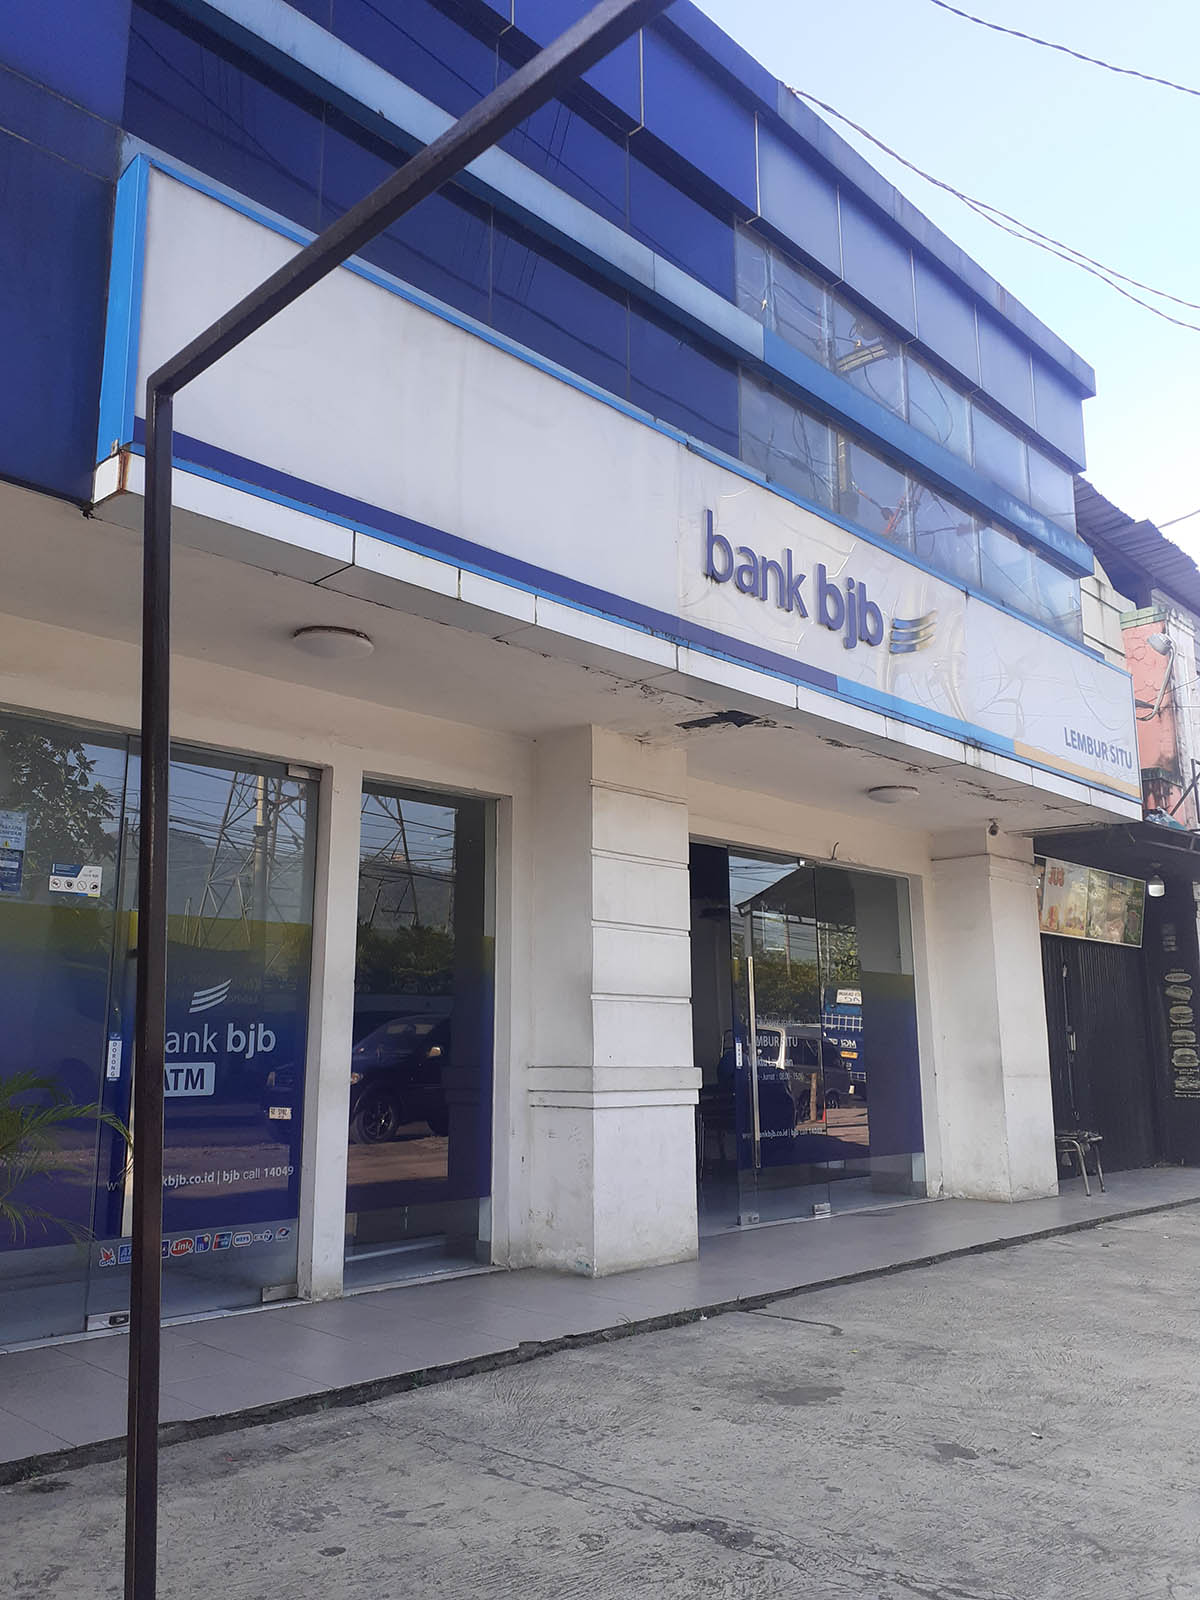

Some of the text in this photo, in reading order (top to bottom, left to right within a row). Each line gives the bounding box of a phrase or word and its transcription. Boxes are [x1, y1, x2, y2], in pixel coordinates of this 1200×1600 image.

[704, 508, 884, 650] bank bjb
[1064, 727, 1132, 769] LEMBUR SITU
[164, 1022, 276, 1059] ank bjb
[746, 1035, 779, 1047] LMBUR
[110, 1041, 118, 1077] DORONG
[223, 1170, 240, 1183] bjb
[243, 1167, 261, 1180] call
[263, 1165, 294, 1178] 14049
